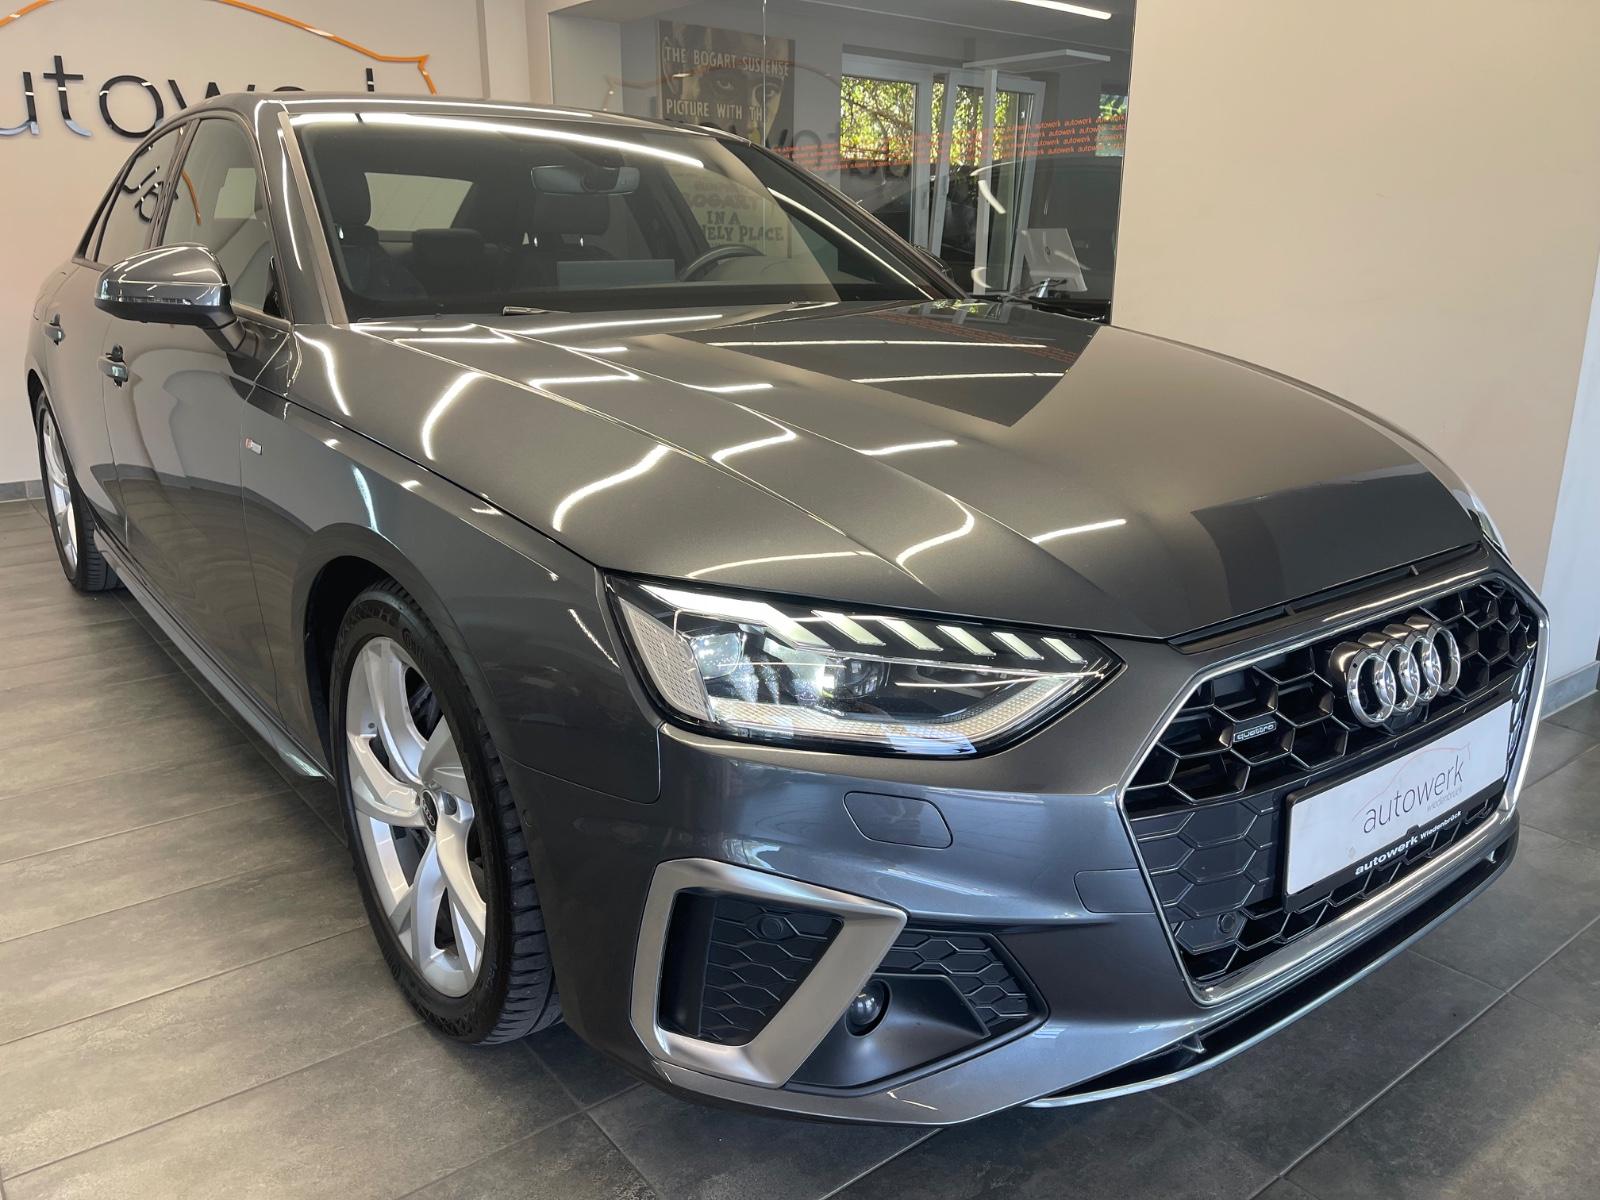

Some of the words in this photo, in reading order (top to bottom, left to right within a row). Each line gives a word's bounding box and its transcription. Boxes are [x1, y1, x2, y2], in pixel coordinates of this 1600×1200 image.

[665, 46, 686, 64] THE
[693, 49, 736, 69] BOGART
[666, 98, 709, 118] PICTURE
[717, 104, 743, 121] WITH
[706, 211, 725, 225] IN
[728, 212, 741, 225] A
[739, 225, 784, 242] PLACE
[1236, 723, 1275, 740] quattro
[1363, 755, 1464, 834] autowerk
[1355, 835, 1418, 876] autowerk
[1420, 810, 1462, 840] Wiedenbrück
